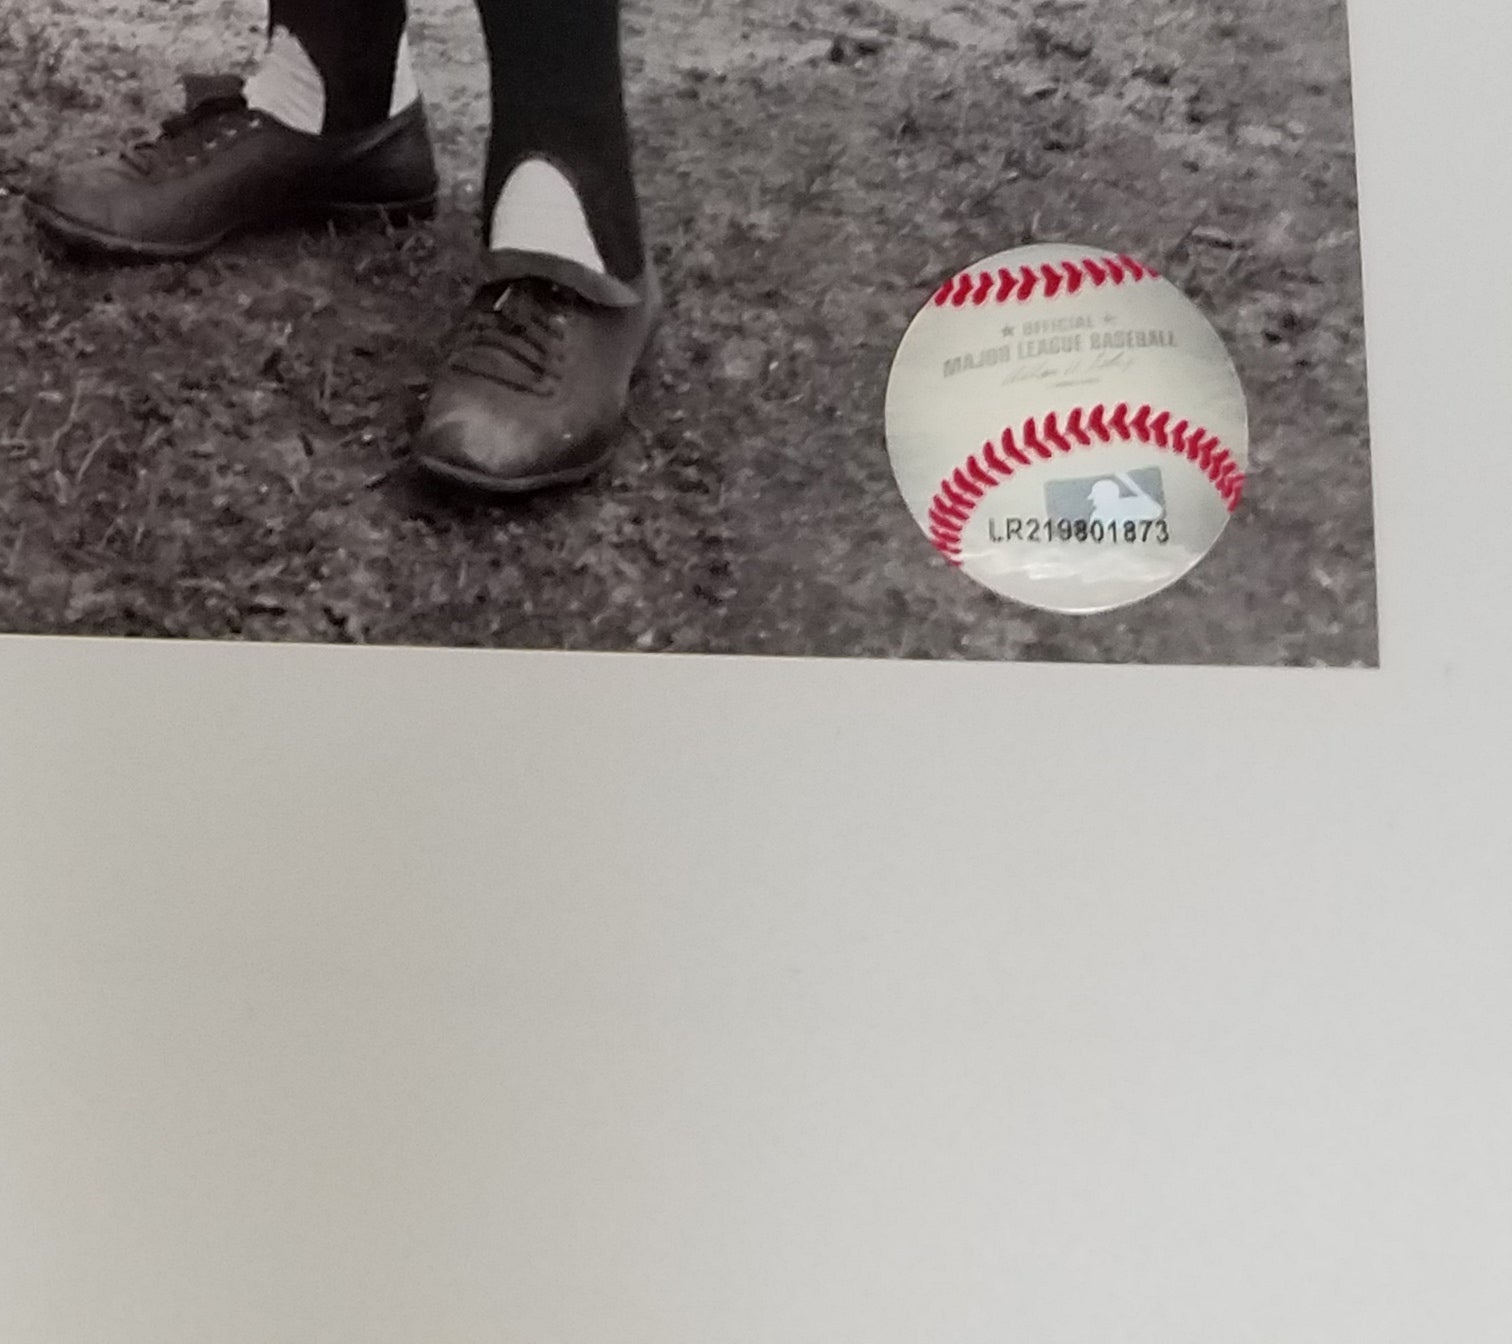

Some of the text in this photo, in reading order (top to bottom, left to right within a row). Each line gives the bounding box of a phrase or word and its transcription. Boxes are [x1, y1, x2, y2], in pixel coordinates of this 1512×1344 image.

[1022, 314, 1094, 337] OFFICIAL
[943, 344, 1011, 378] MAJOR
[1017, 333, 1082, 360] LEAGUE
[1090, 330, 1177, 350] BASEBALL
[988, 518, 1170, 544] LR219801873
